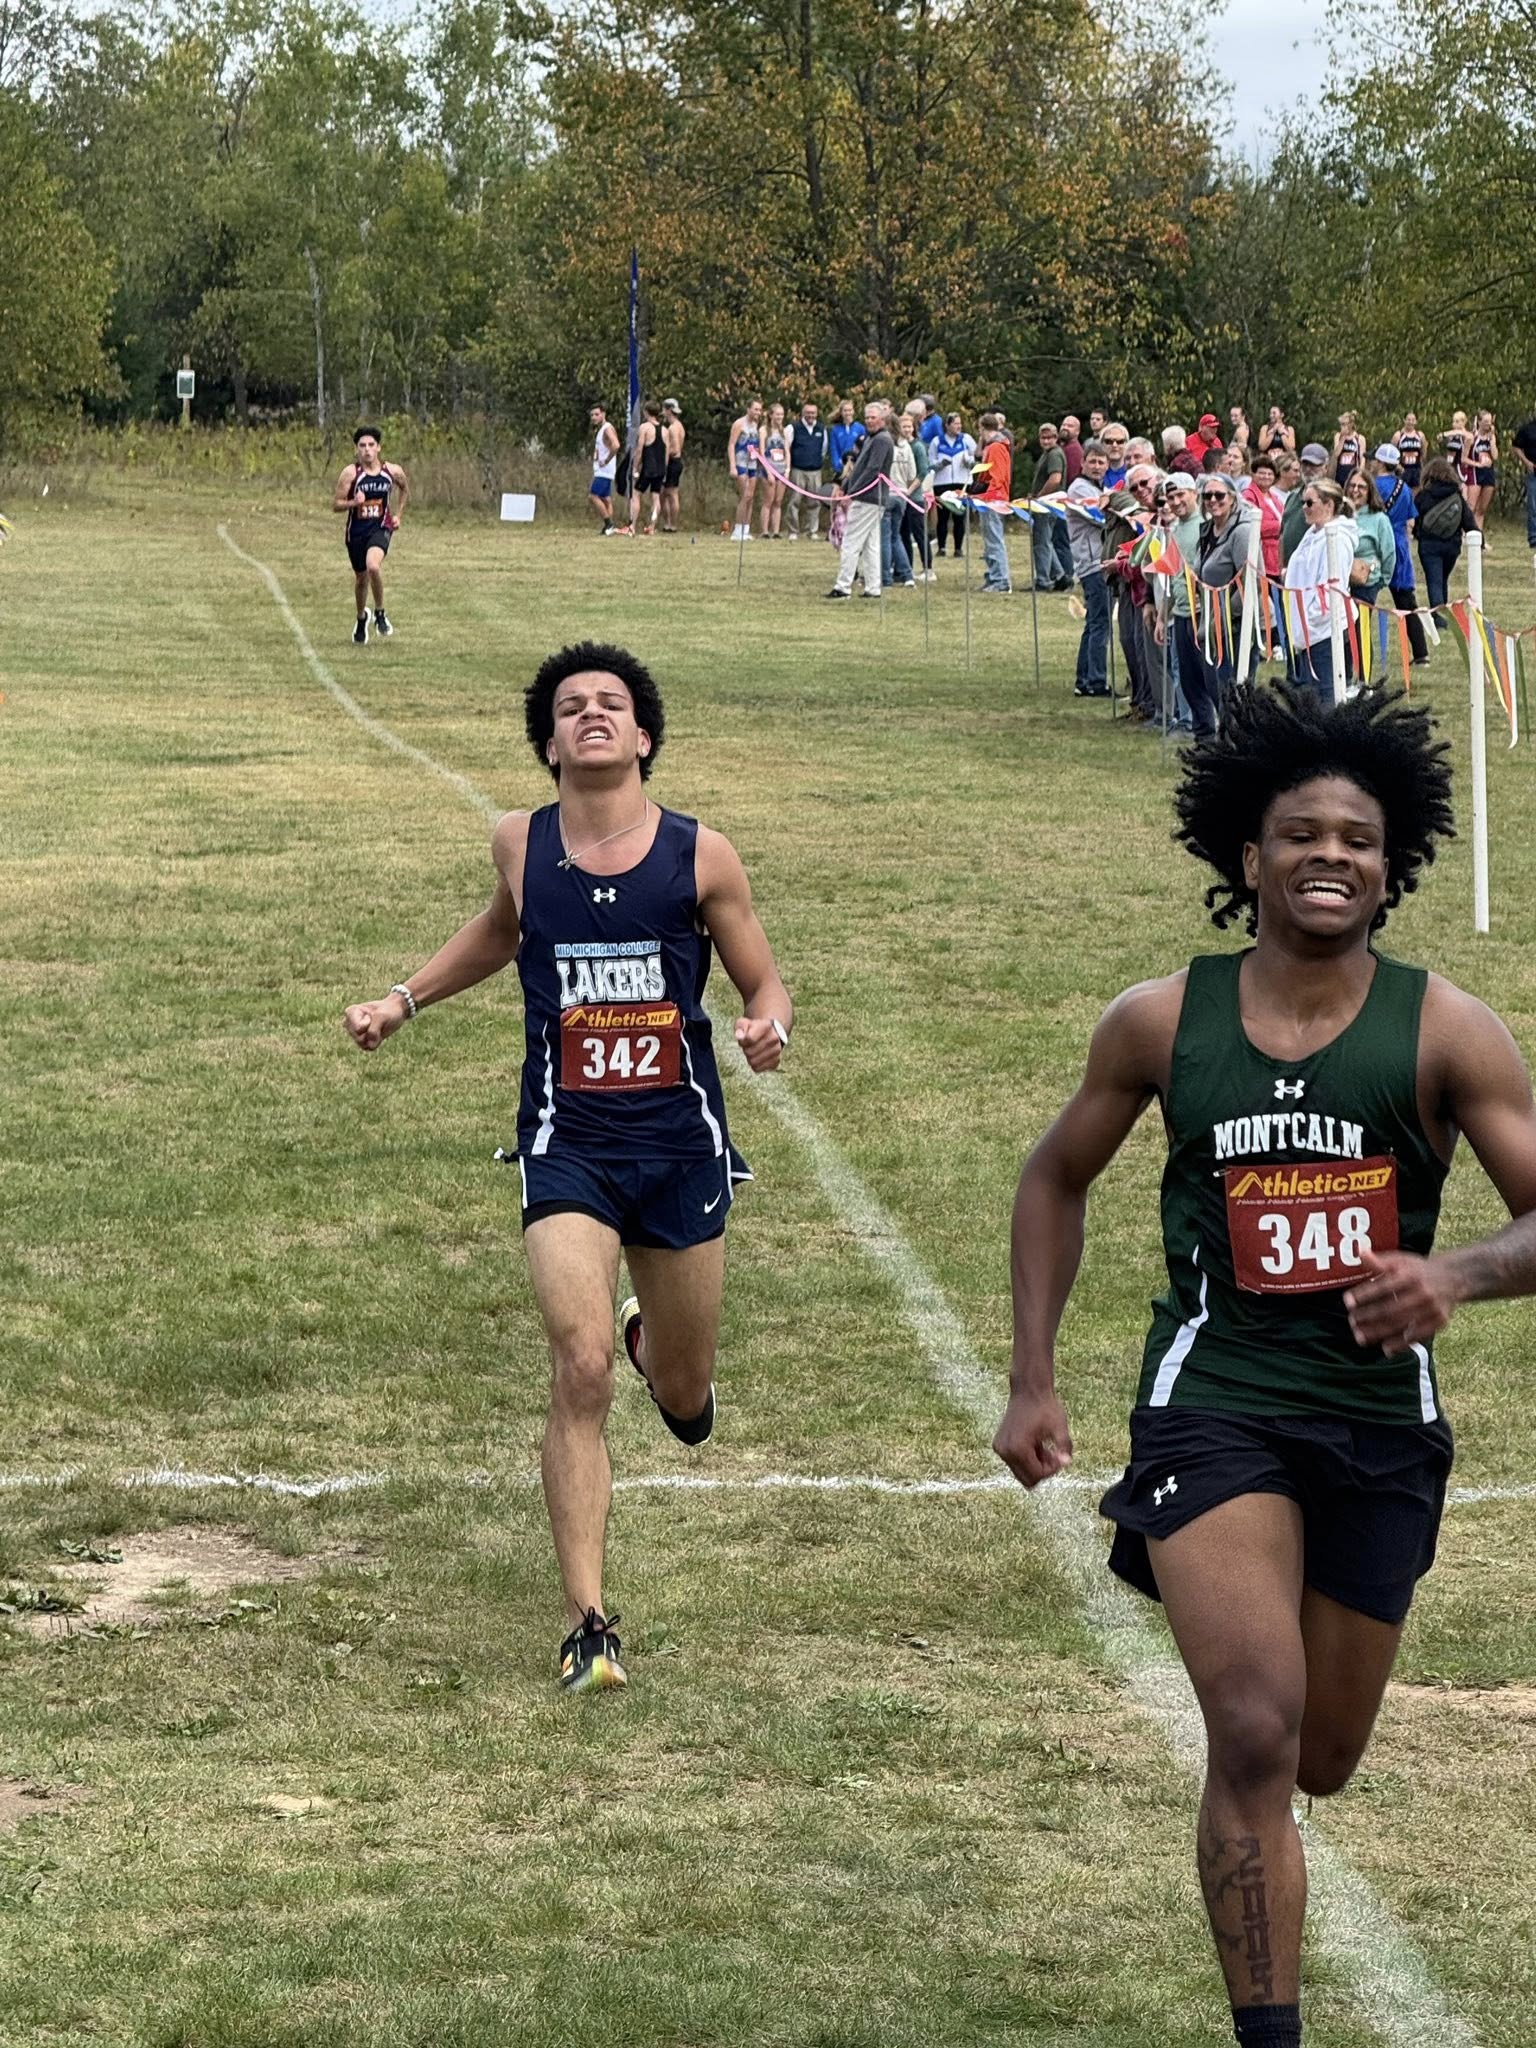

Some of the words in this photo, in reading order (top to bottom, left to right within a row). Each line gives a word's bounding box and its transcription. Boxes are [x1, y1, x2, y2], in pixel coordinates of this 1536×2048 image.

[555, 944, 571, 957] MID
[573, 943, 617, 957] MICHIGAN
[619, 941, 660, 956] COLLEGE
[557, 954, 666, 1009] LAKERS
[582, 1035, 661, 1079] 342
[1213, 1112, 1364, 1160] MONTCALM
[1258, 1206, 1372, 1275] 348
